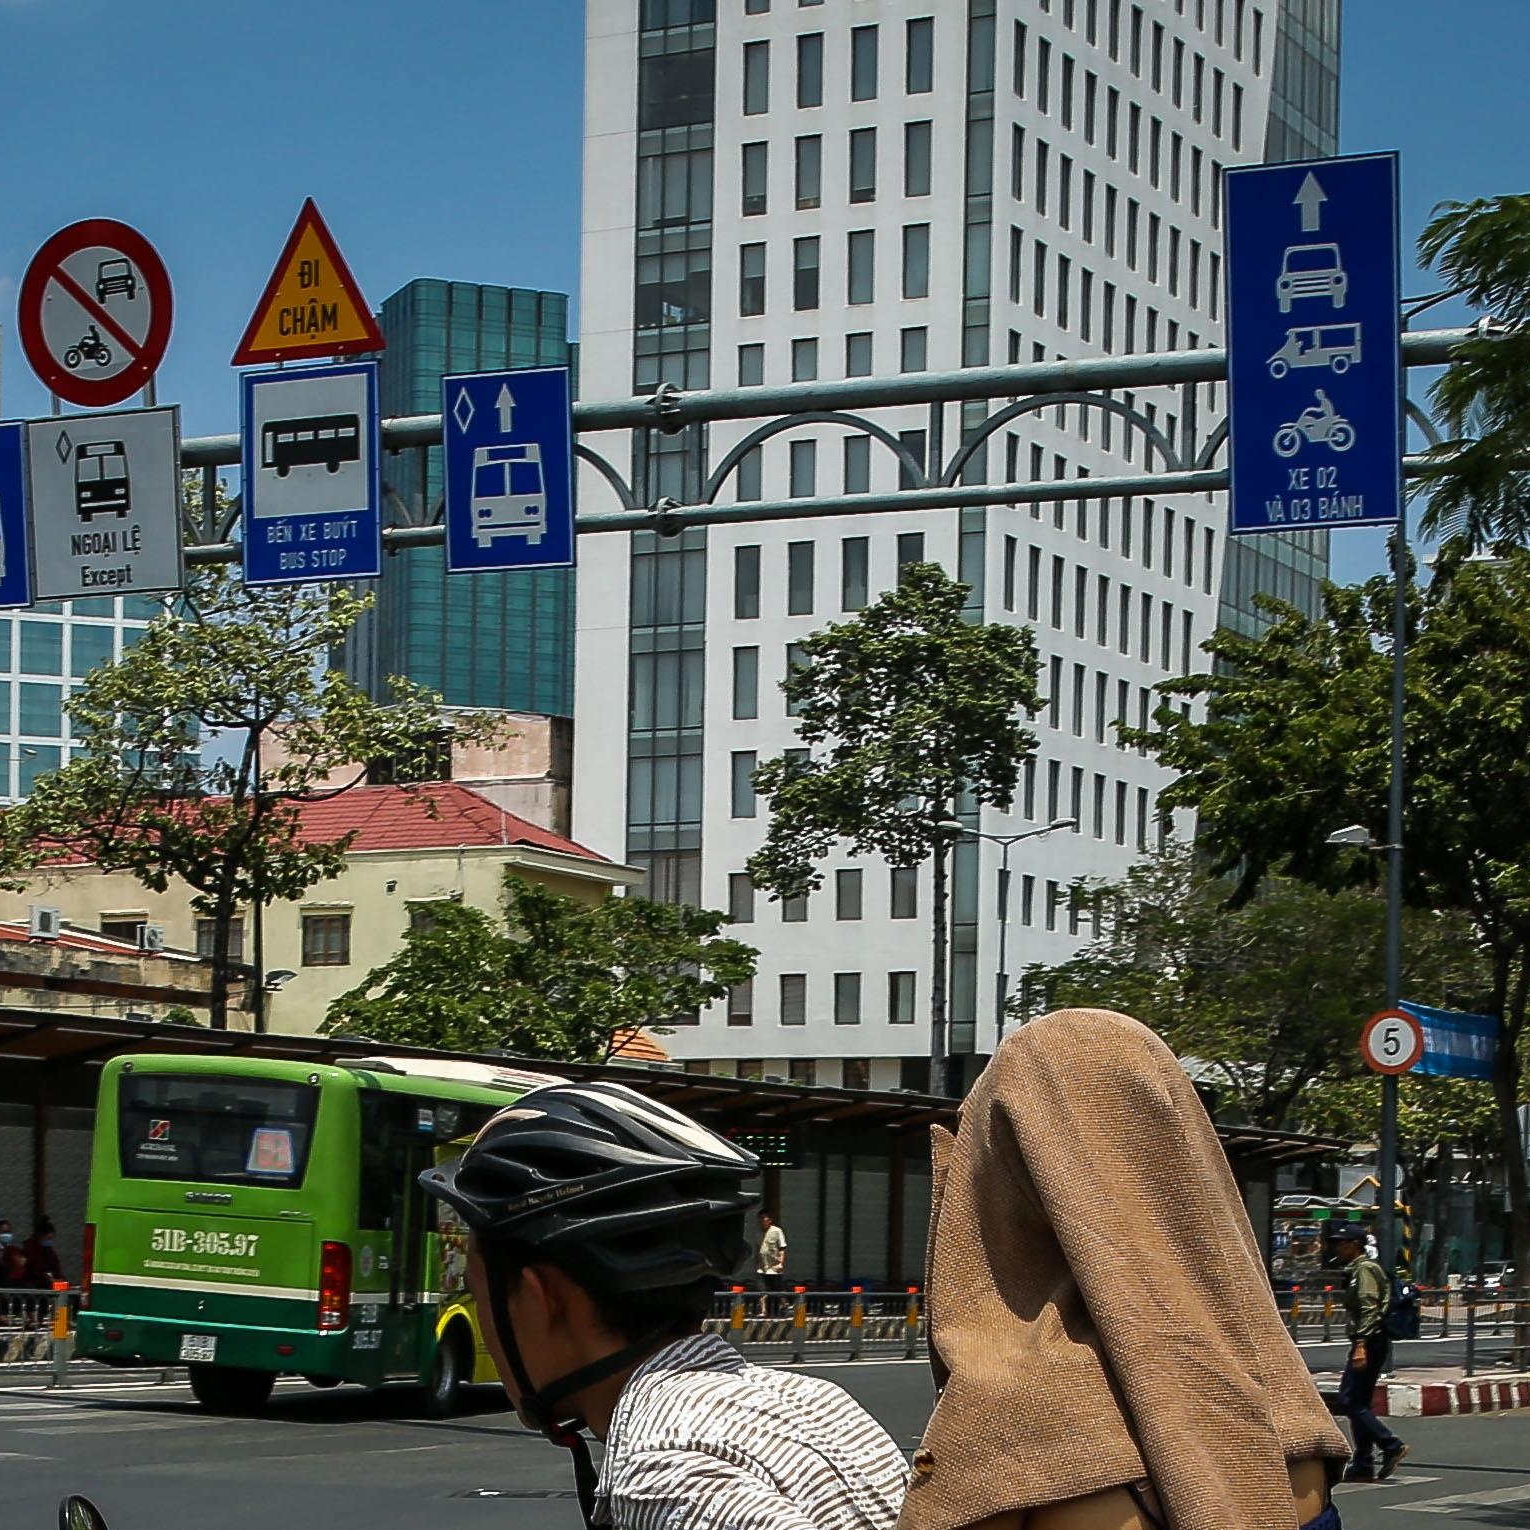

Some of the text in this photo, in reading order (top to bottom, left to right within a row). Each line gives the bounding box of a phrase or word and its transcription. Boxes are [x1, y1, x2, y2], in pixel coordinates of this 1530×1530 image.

[298, 259, 320, 289] ĐI
[278, 298, 338, 339] CHẬM
[1287, 466, 1338, 491] XE 02
[1265, 490, 1364, 523] VÀ 03 BÁNH
[70, 524, 142, 557] NGOẠI LỆ
[266, 515, 358, 544] BẾN XE BUÝT
[279, 548, 347, 570] BUS STOP
[81, 563, 133, 588] Except
[1383, 1027, 1401, 1056] 5
[151, 1228, 260, 1258] 51B-305.97
